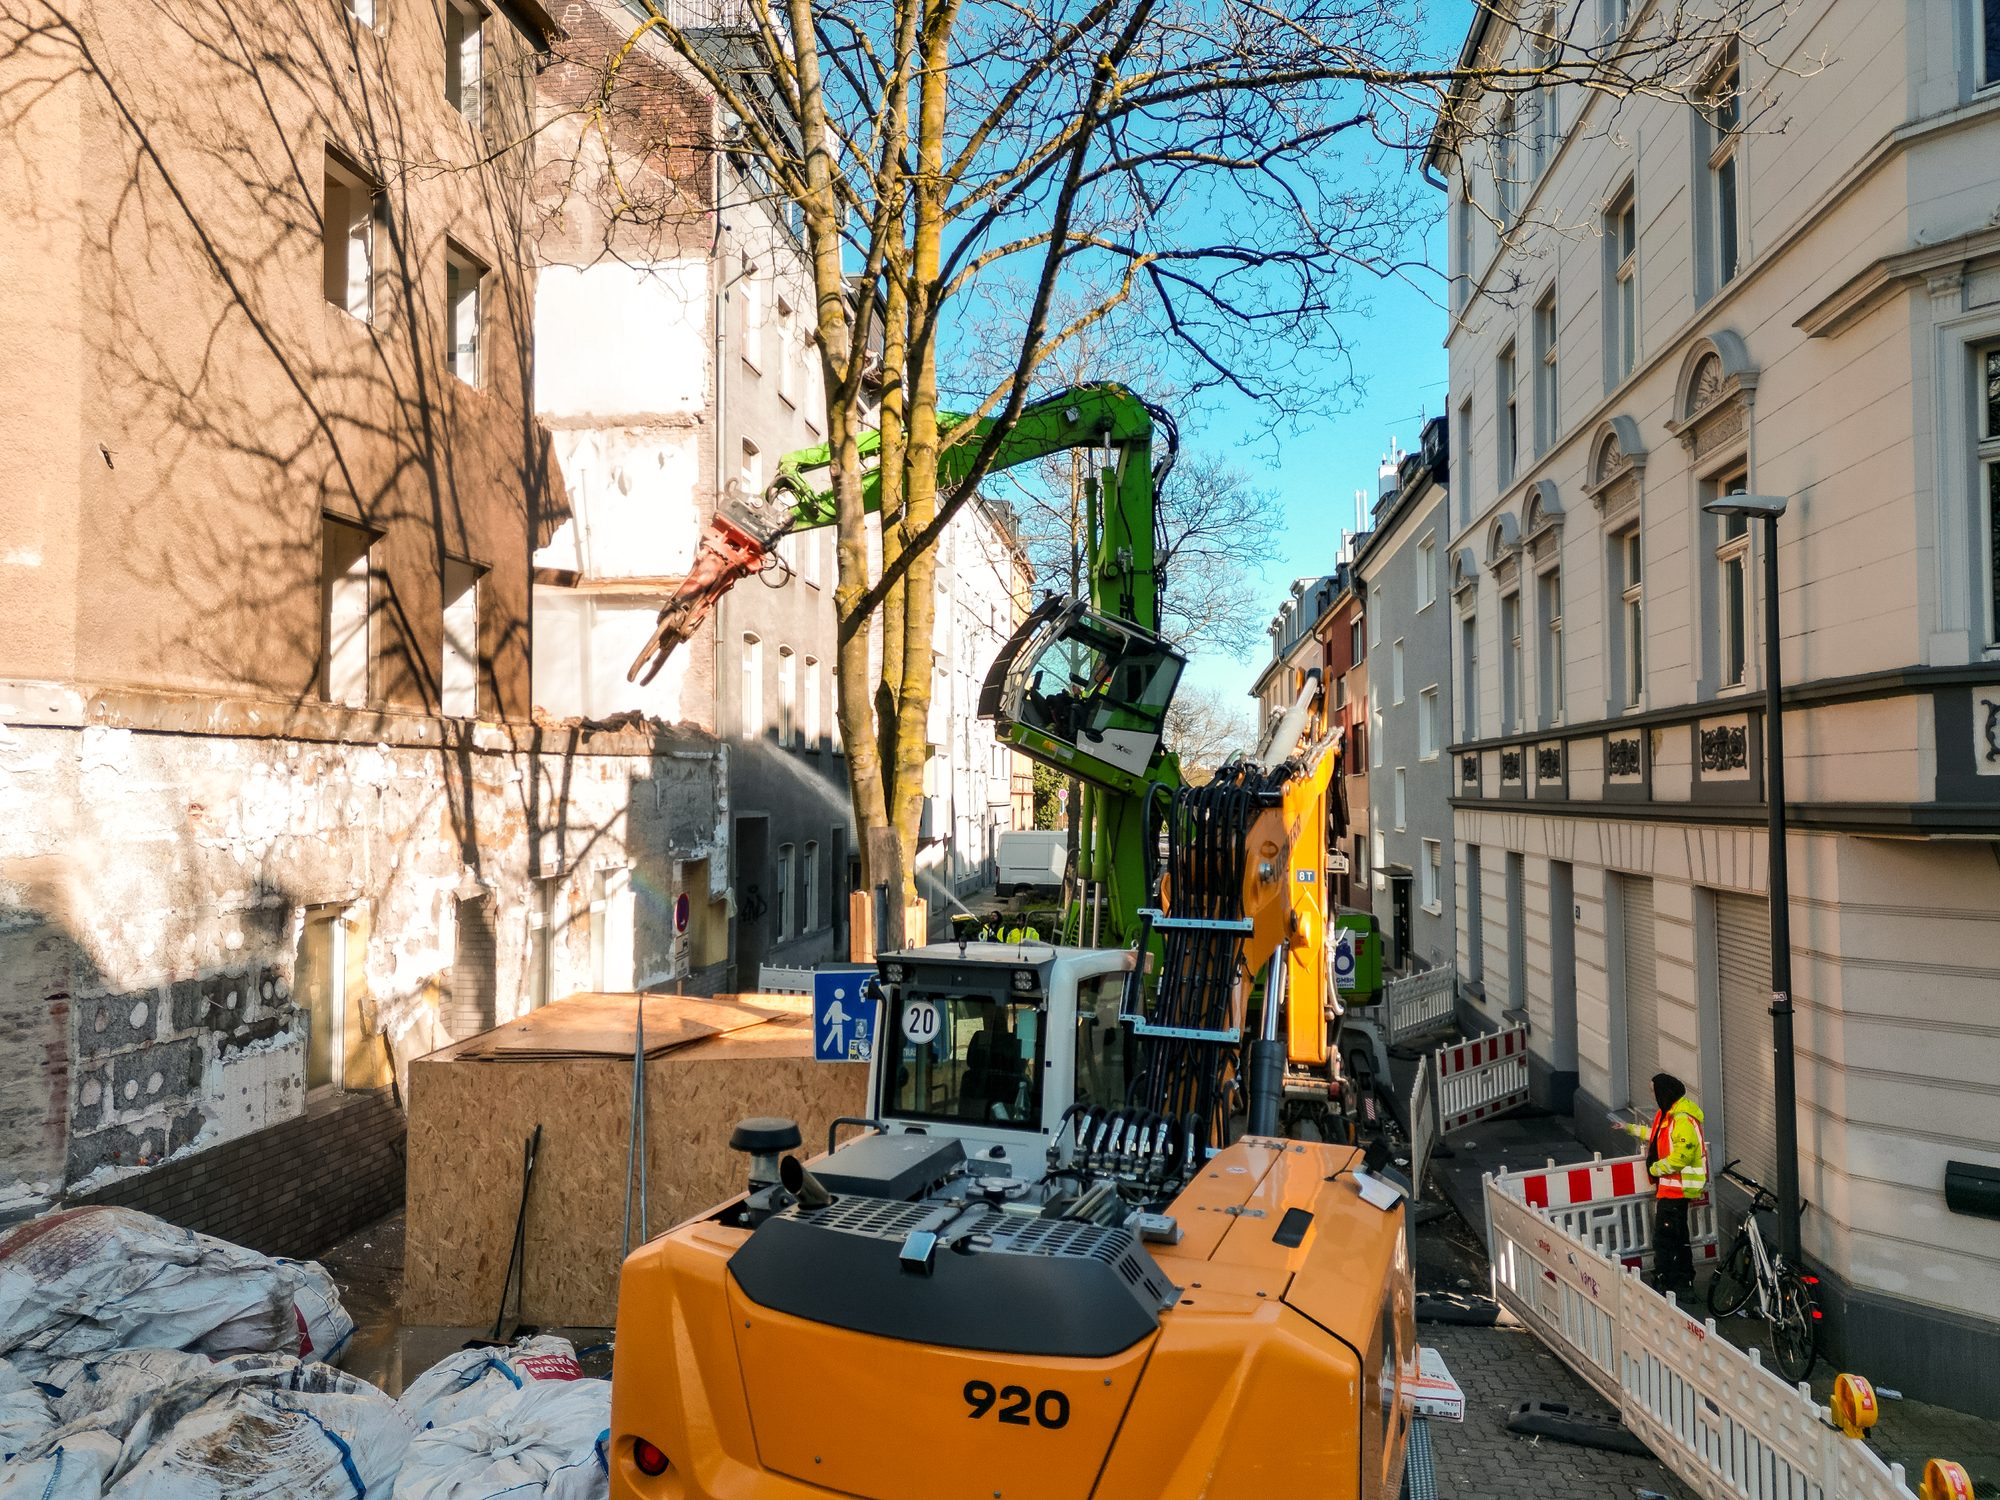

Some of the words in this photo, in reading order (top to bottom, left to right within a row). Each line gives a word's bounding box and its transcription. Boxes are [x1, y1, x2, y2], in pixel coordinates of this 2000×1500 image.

[909, 1007, 934, 1034] 20
[1687, 1320, 1705, 1342] step
[530, 1365, 577, 1377] WOLLE
[963, 1380, 1070, 1430] 920
